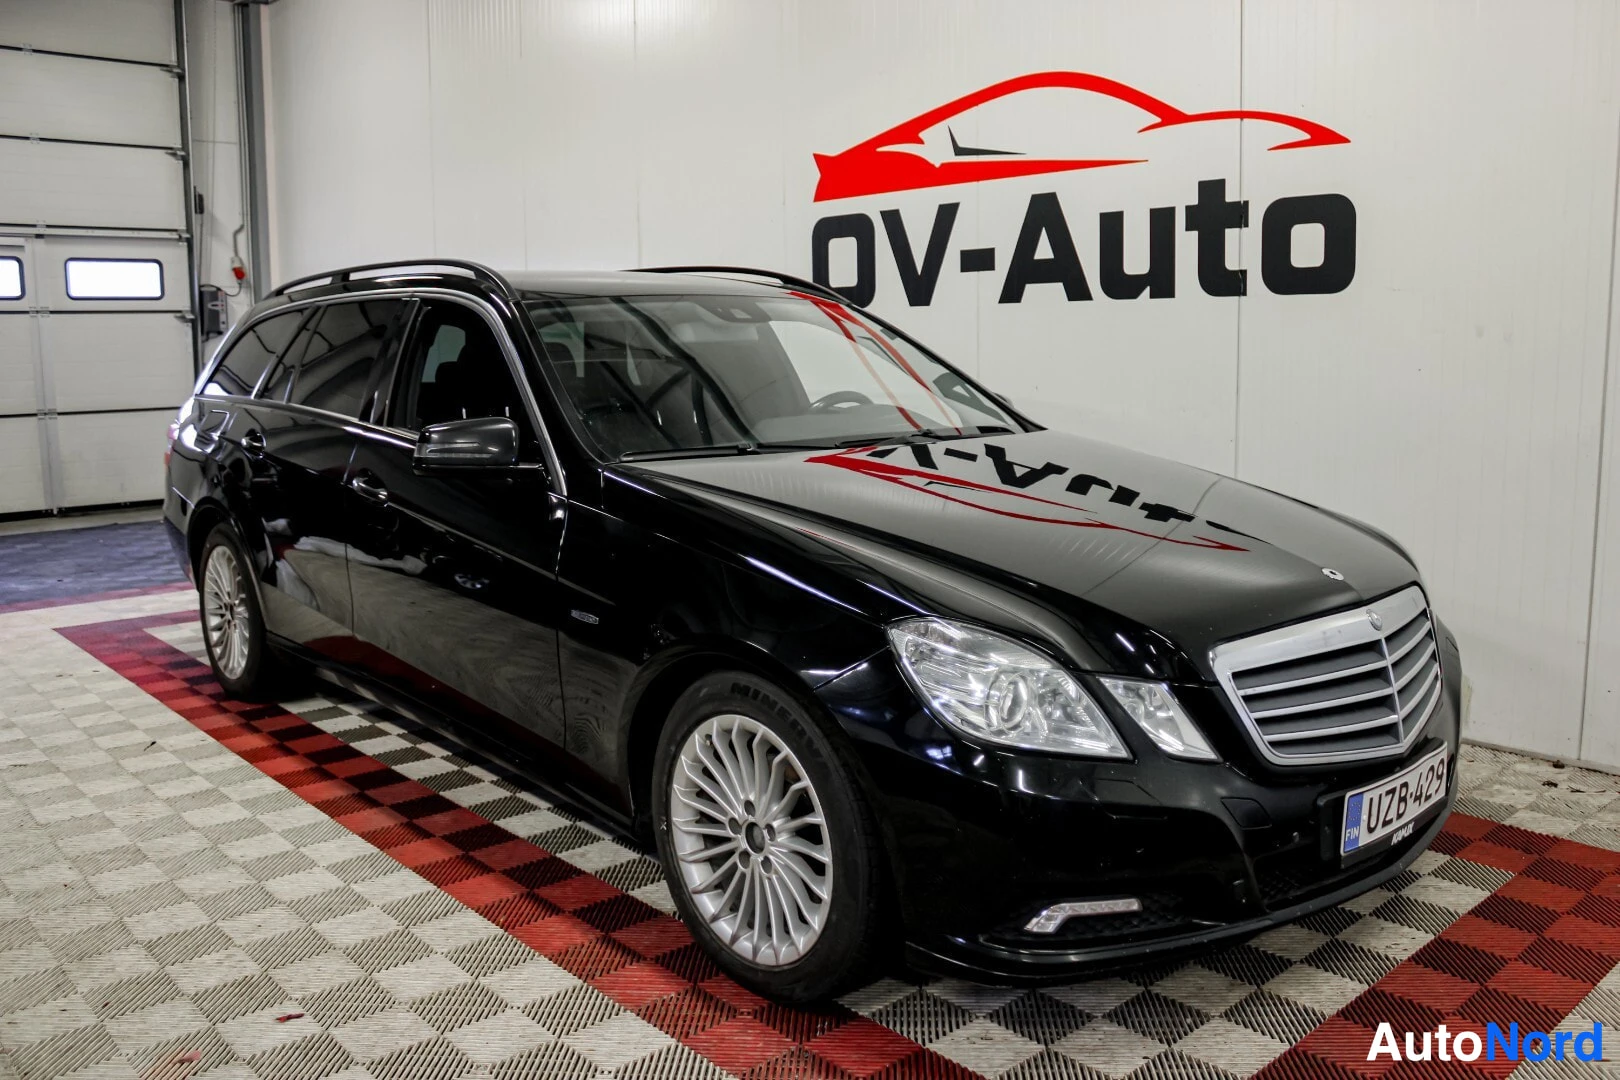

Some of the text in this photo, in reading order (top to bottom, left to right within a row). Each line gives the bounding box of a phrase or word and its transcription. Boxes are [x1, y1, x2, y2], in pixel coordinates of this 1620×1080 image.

[812, 178, 1357, 308] OV-Auto
[731, 682, 827, 768] MINERV
[1345, 826, 1360, 842] FIN
[1366, 757, 1445, 834] UZB-429
